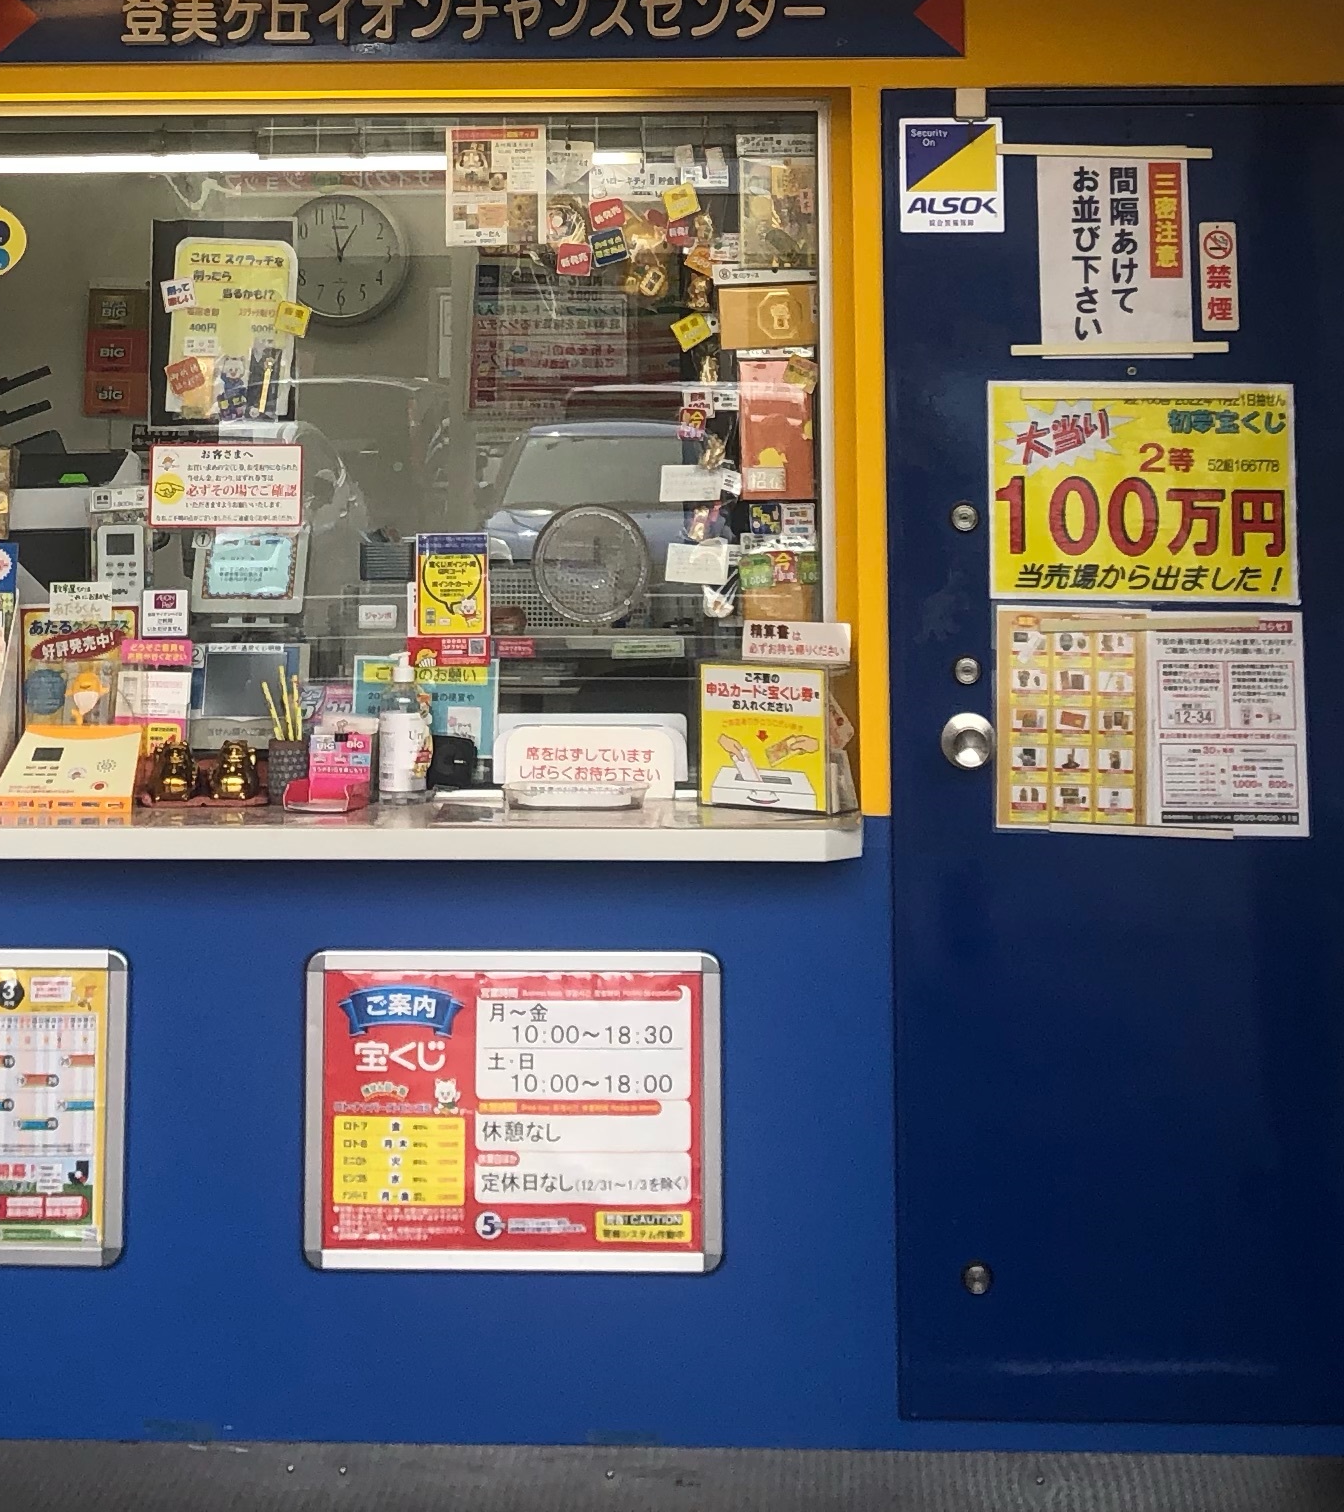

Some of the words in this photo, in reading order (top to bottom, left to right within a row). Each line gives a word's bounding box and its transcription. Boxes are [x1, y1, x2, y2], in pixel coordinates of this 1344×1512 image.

[910, 128, 948, 138] Security
[922, 138, 936, 146] On
[336, 204, 346, 220] 12
[907, 197, 998, 215] ALSOK
[1154, 172, 1178, 268] 三密注意
[377, 223, 384, 240] 2
[1109, 166, 1140, 313] 間隔あけて
[1071, 166, 1102, 340] お並び下さい
[376, 270, 383, 286] 4
[337, 289, 346, 307] 6
[359, 284, 366, 301] 5
[1206, 264, 1233, 321] 禁煙
[100, 346, 125, 358] BIG
[1167, 409, 1287, 435] 初夢宝くじ
[1017, 408, 1110, 465] 大当り
[201, 449, 254, 460] お客さまへ
[1139, 443, 1194, 473] 2等
[186, 484, 298, 497] 必ずその場でご確認
[996, 476, 1287, 556] 100万円
[750, 623, 790, 639] 精算書
[749, 642, 846, 656] 必ずお持ち帰りください
[732, 700, 794, 713] お入れください
[1175, 710, 1212, 724] 12-34
[525, 746, 655, 763] 席をはずしています
[520, 764, 661, 783] しばらくお待ち下さい
[365, 994, 437, 1018] ご案内
[354, 1040, 446, 1073] 宝くじ
[482, 1121, 561, 1143] 休憩なし
[481, 1215, 496, 1236] 5
